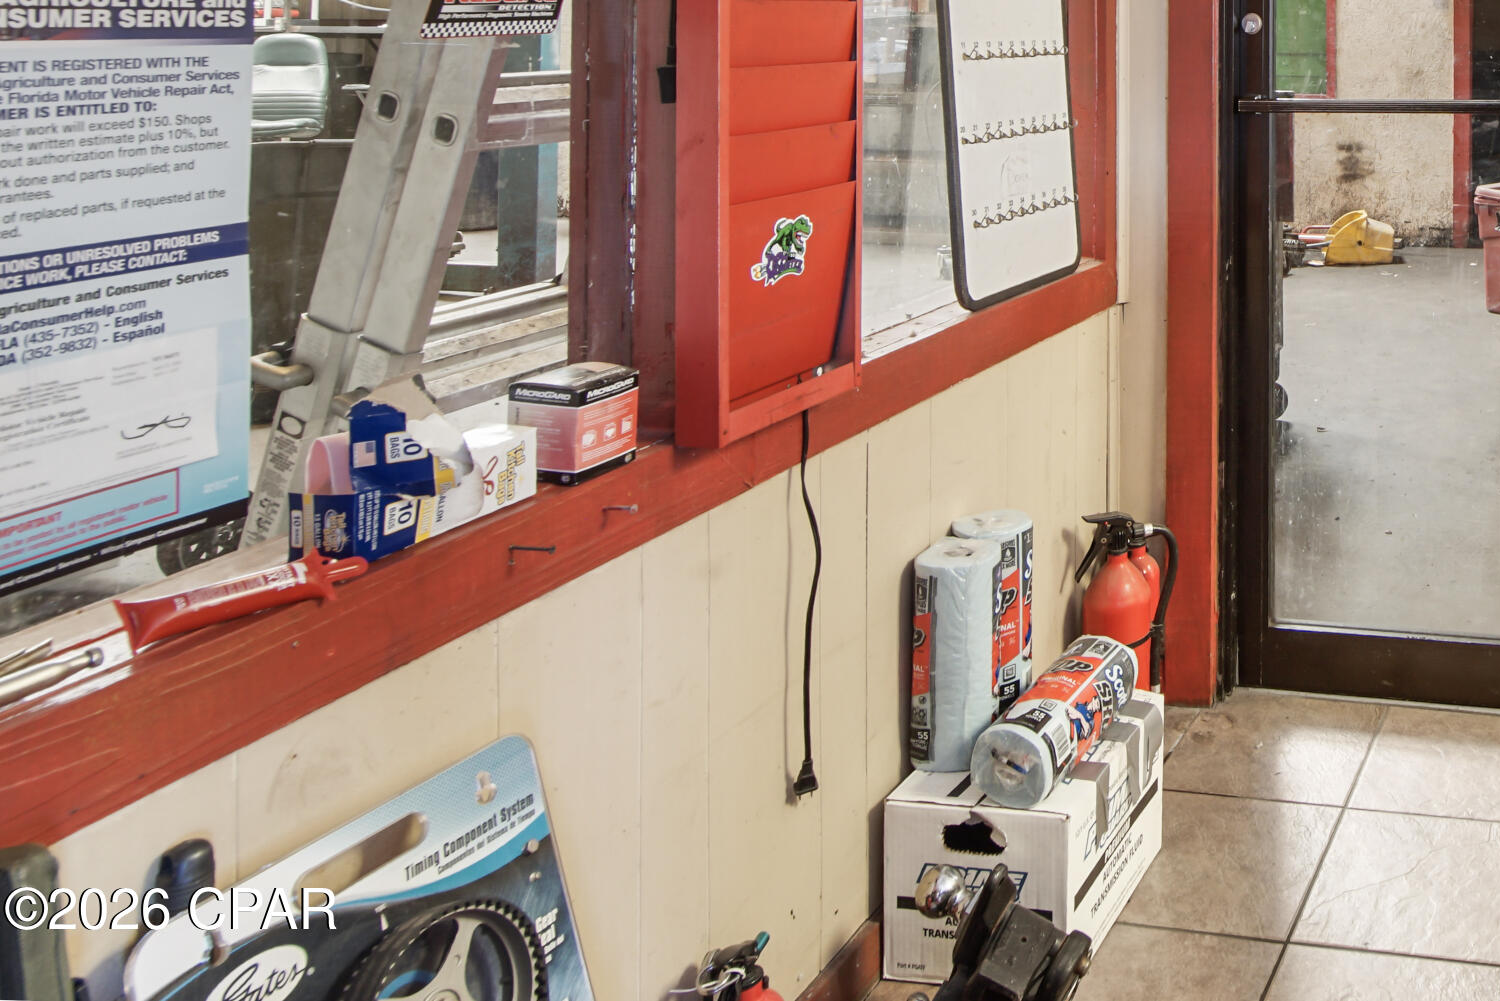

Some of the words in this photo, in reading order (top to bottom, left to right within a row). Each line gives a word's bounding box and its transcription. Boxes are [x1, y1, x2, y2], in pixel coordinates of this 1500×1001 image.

[118, 9, 246, 28] SERVICES
[498, 3, 552, 12] DETECTION
[33, 60, 47, 73] IS
[52, 58, 142, 72] REGISTERED
[146, 56, 181, 69] WITH
[185, 56, 209, 68] THE
[80, 73, 107, 86] and
[111, 72, 181, 85] Consumer
[186, 70, 240, 82] Services
[8, 92, 59, 105] Florida
[64, 89, 107, 102] Motor
[110, 87, 160, 100] Vehicle
[164, 84, 206, 98] Repair
[210, 83, 234, 96] Act,
[35, 106, 49, 118] IS
[56, 102, 129, 117] ENTITLED
[135, 101, 157, 113] TO:
[43, 254, 63, 267] OR
[66, 241, 151, 264] UNRESOLVED
[154, 230, 220, 250] PROBLEMS
[25, 267, 72, 286] WORK,
[75, 259, 125, 278] PLEASE
[128, 250, 187, 269] CONTACT:
[114, 310, 163, 328] English
[113, 324, 165, 342] Español
[515, 388, 571, 400] MICROGARD
[586, 378, 634, 399] MICROGARD
[389, 437, 400, 459] BAGS
[516, 441, 526, 467] Tall
[507, 448, 517, 500] Kitchen
[497, 471, 507, 505] Bags
[388, 507, 397, 530] BAGS
[397, 501, 413, 526] 10
[1004, 685, 1015, 695] 55
[917, 732, 928, 741] 55
[405, 851, 440, 882] Timing
[443, 813, 498, 858] Component
[500, 794, 534, 823] System
[1103, 832, 1132, 886] AUTOMATIC
[1091, 858, 1129, 919] TRANSMISSION
[1128, 833, 1144, 862] FLUID
